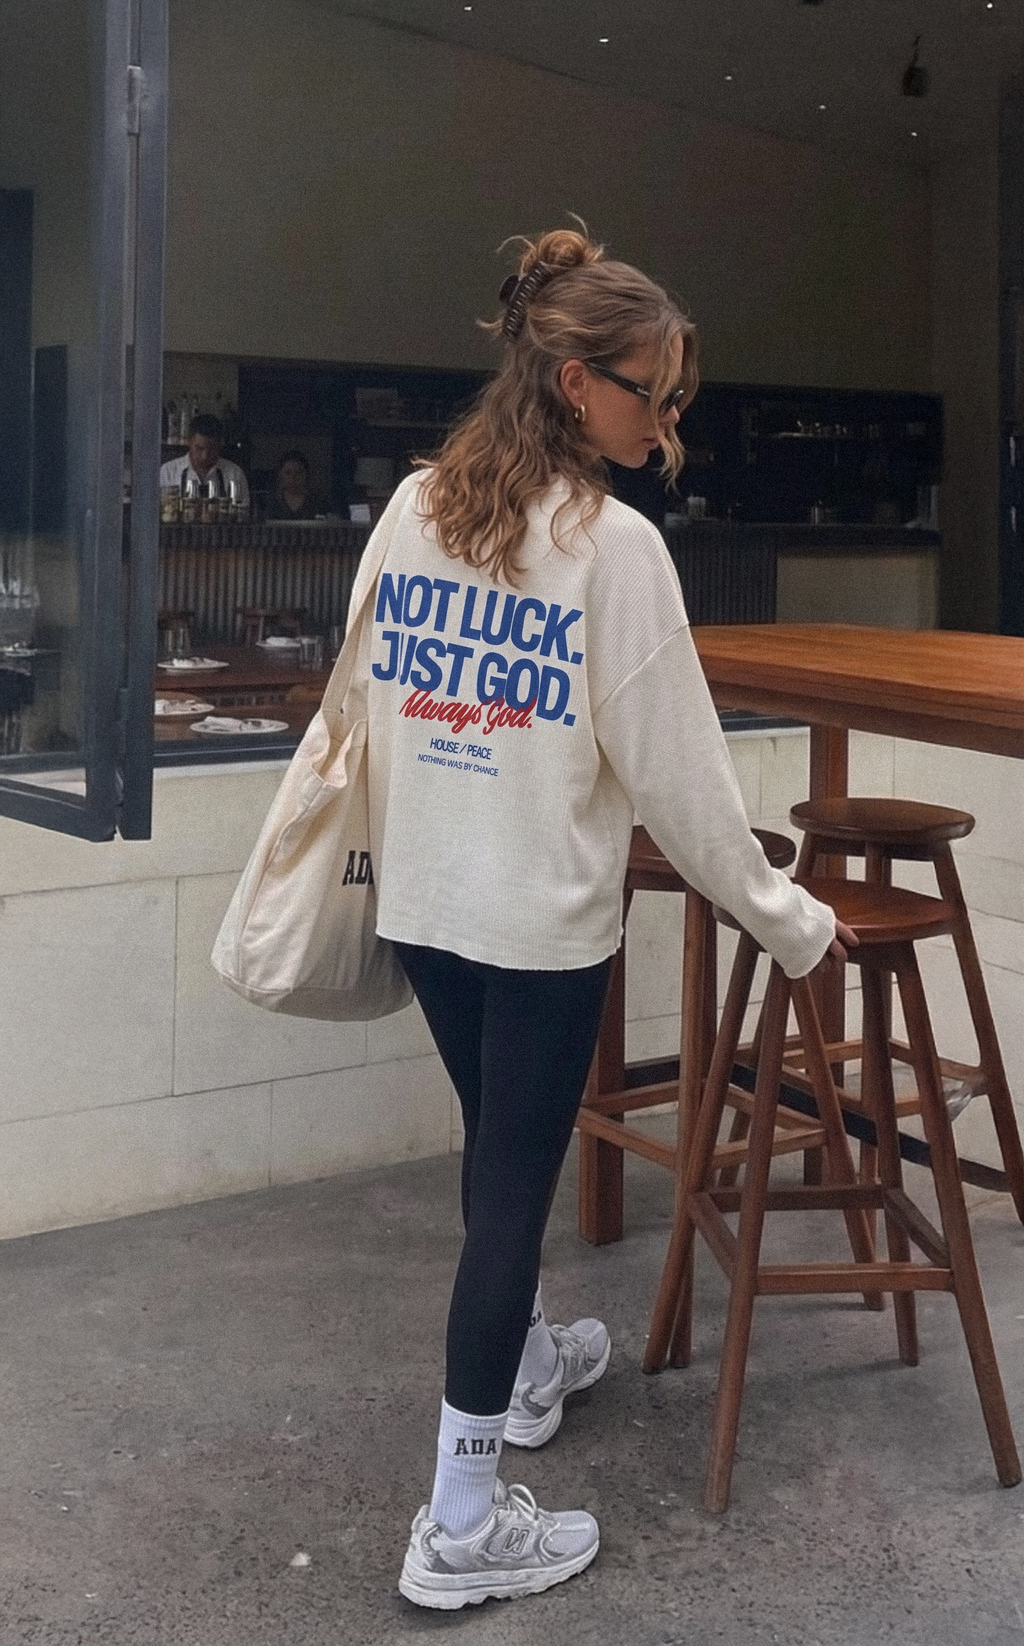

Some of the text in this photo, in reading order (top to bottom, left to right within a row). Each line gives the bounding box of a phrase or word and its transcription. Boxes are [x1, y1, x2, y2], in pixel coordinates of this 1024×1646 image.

[375, 572, 584, 666] NOT LUCK.
[371, 630, 577, 727] JUST GOD.
[398, 687, 537, 736] Always God.
[417, 753, 499, 777] NOTHING WAS BY CHANCE
[429, 737, 460, 754] HOUSE
[466, 744, 492, 760] PEACE
[454, 1438, 497, 1455] ADA
